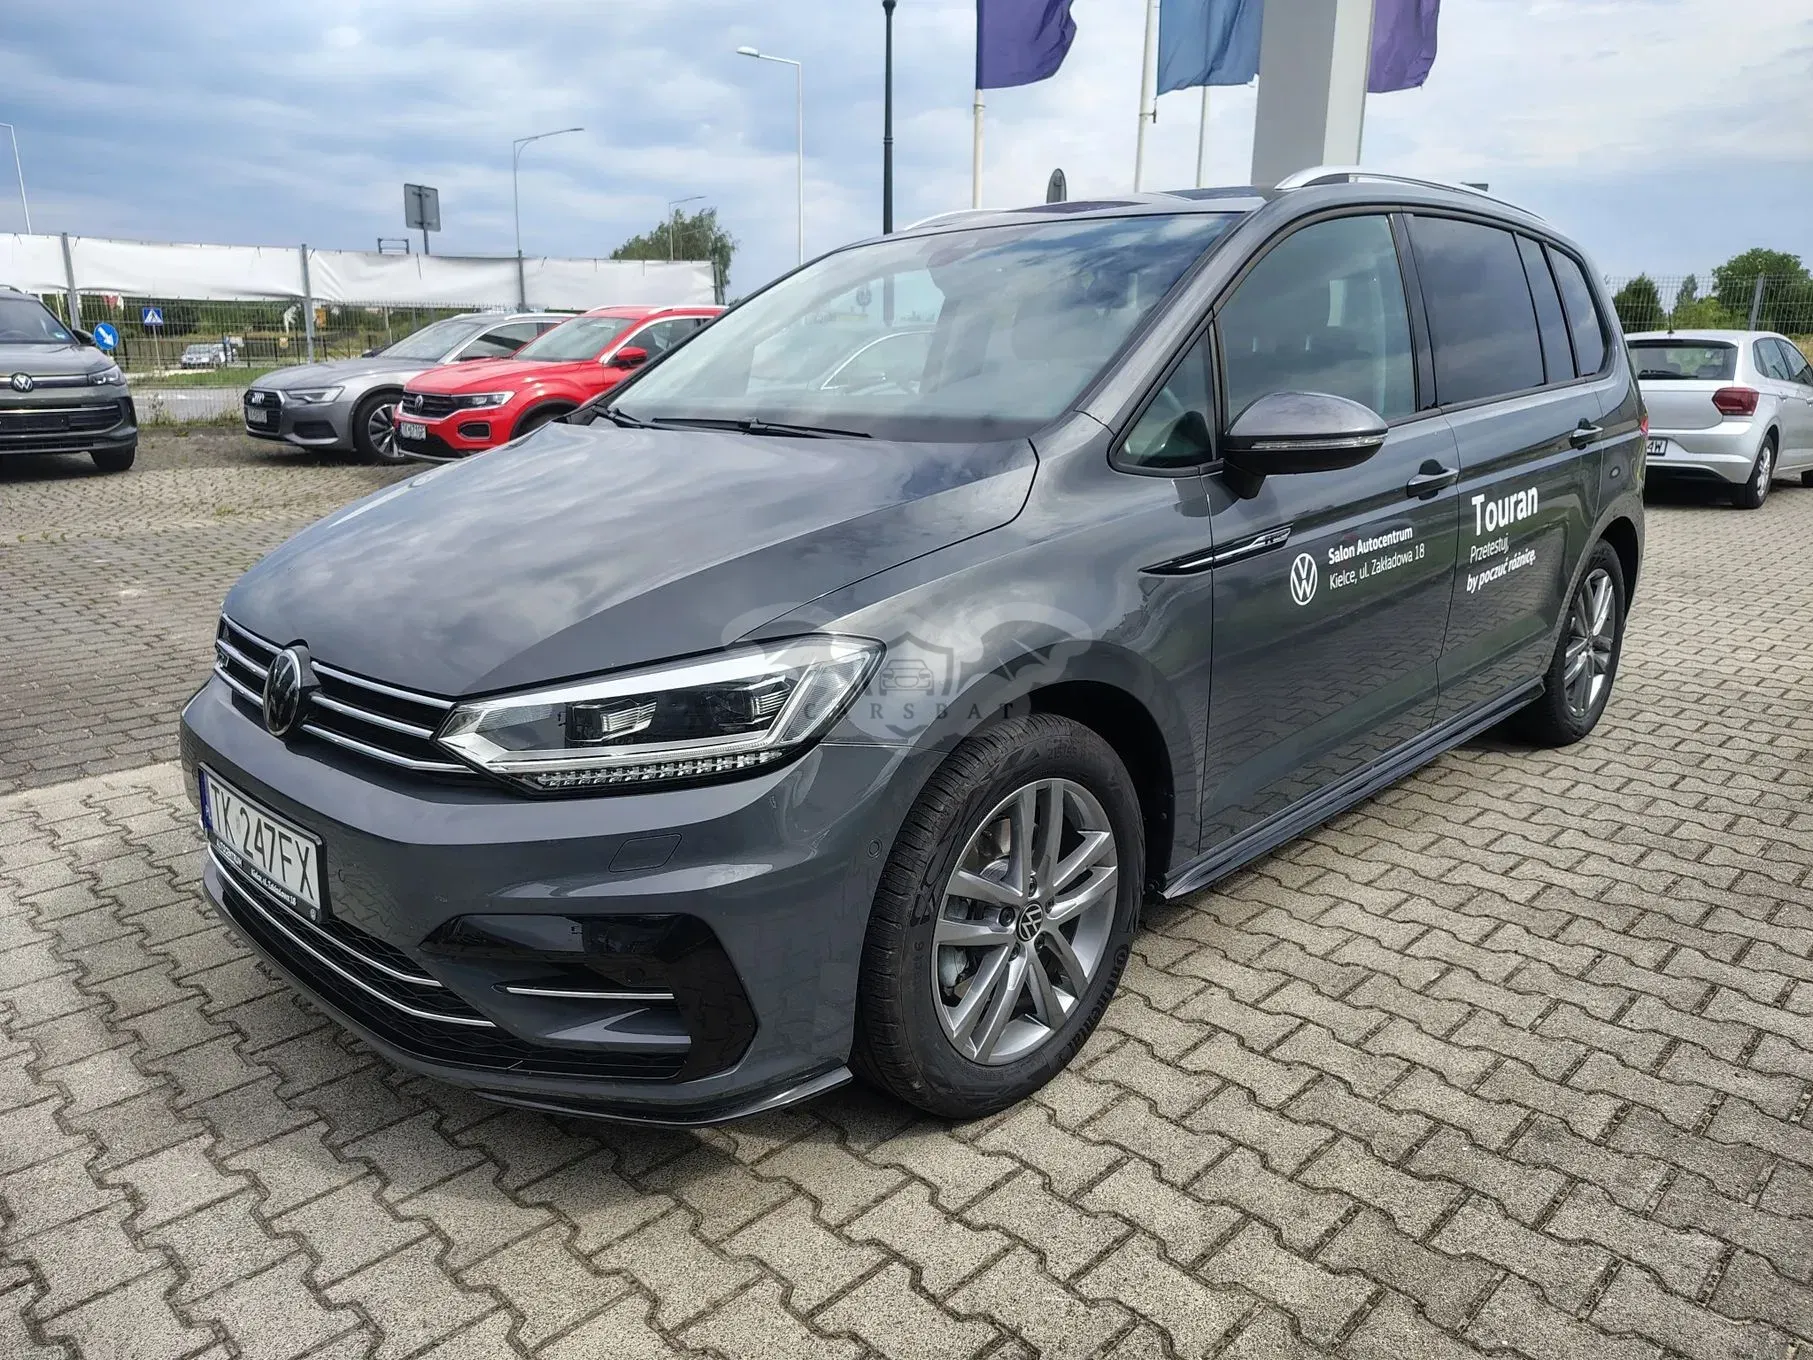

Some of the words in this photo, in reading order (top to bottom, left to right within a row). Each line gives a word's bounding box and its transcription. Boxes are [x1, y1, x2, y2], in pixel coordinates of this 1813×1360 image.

[1471, 486, 1538, 536] Touran
[1328, 545, 1355, 565] Salon
[1357, 527, 1413, 554] Autocentrum
[1329, 569, 1357, 590] Kielce,
[1359, 563, 1370, 579] ul.
[1371, 550, 1413, 576] Zakładowa
[1415, 543, 1425, 560] 18
[1466, 573, 1479, 594] by
[1478, 556, 1508, 591] poczuć
[211, 784, 236, 845] TK
[240, 807, 314, 900] 247FX
